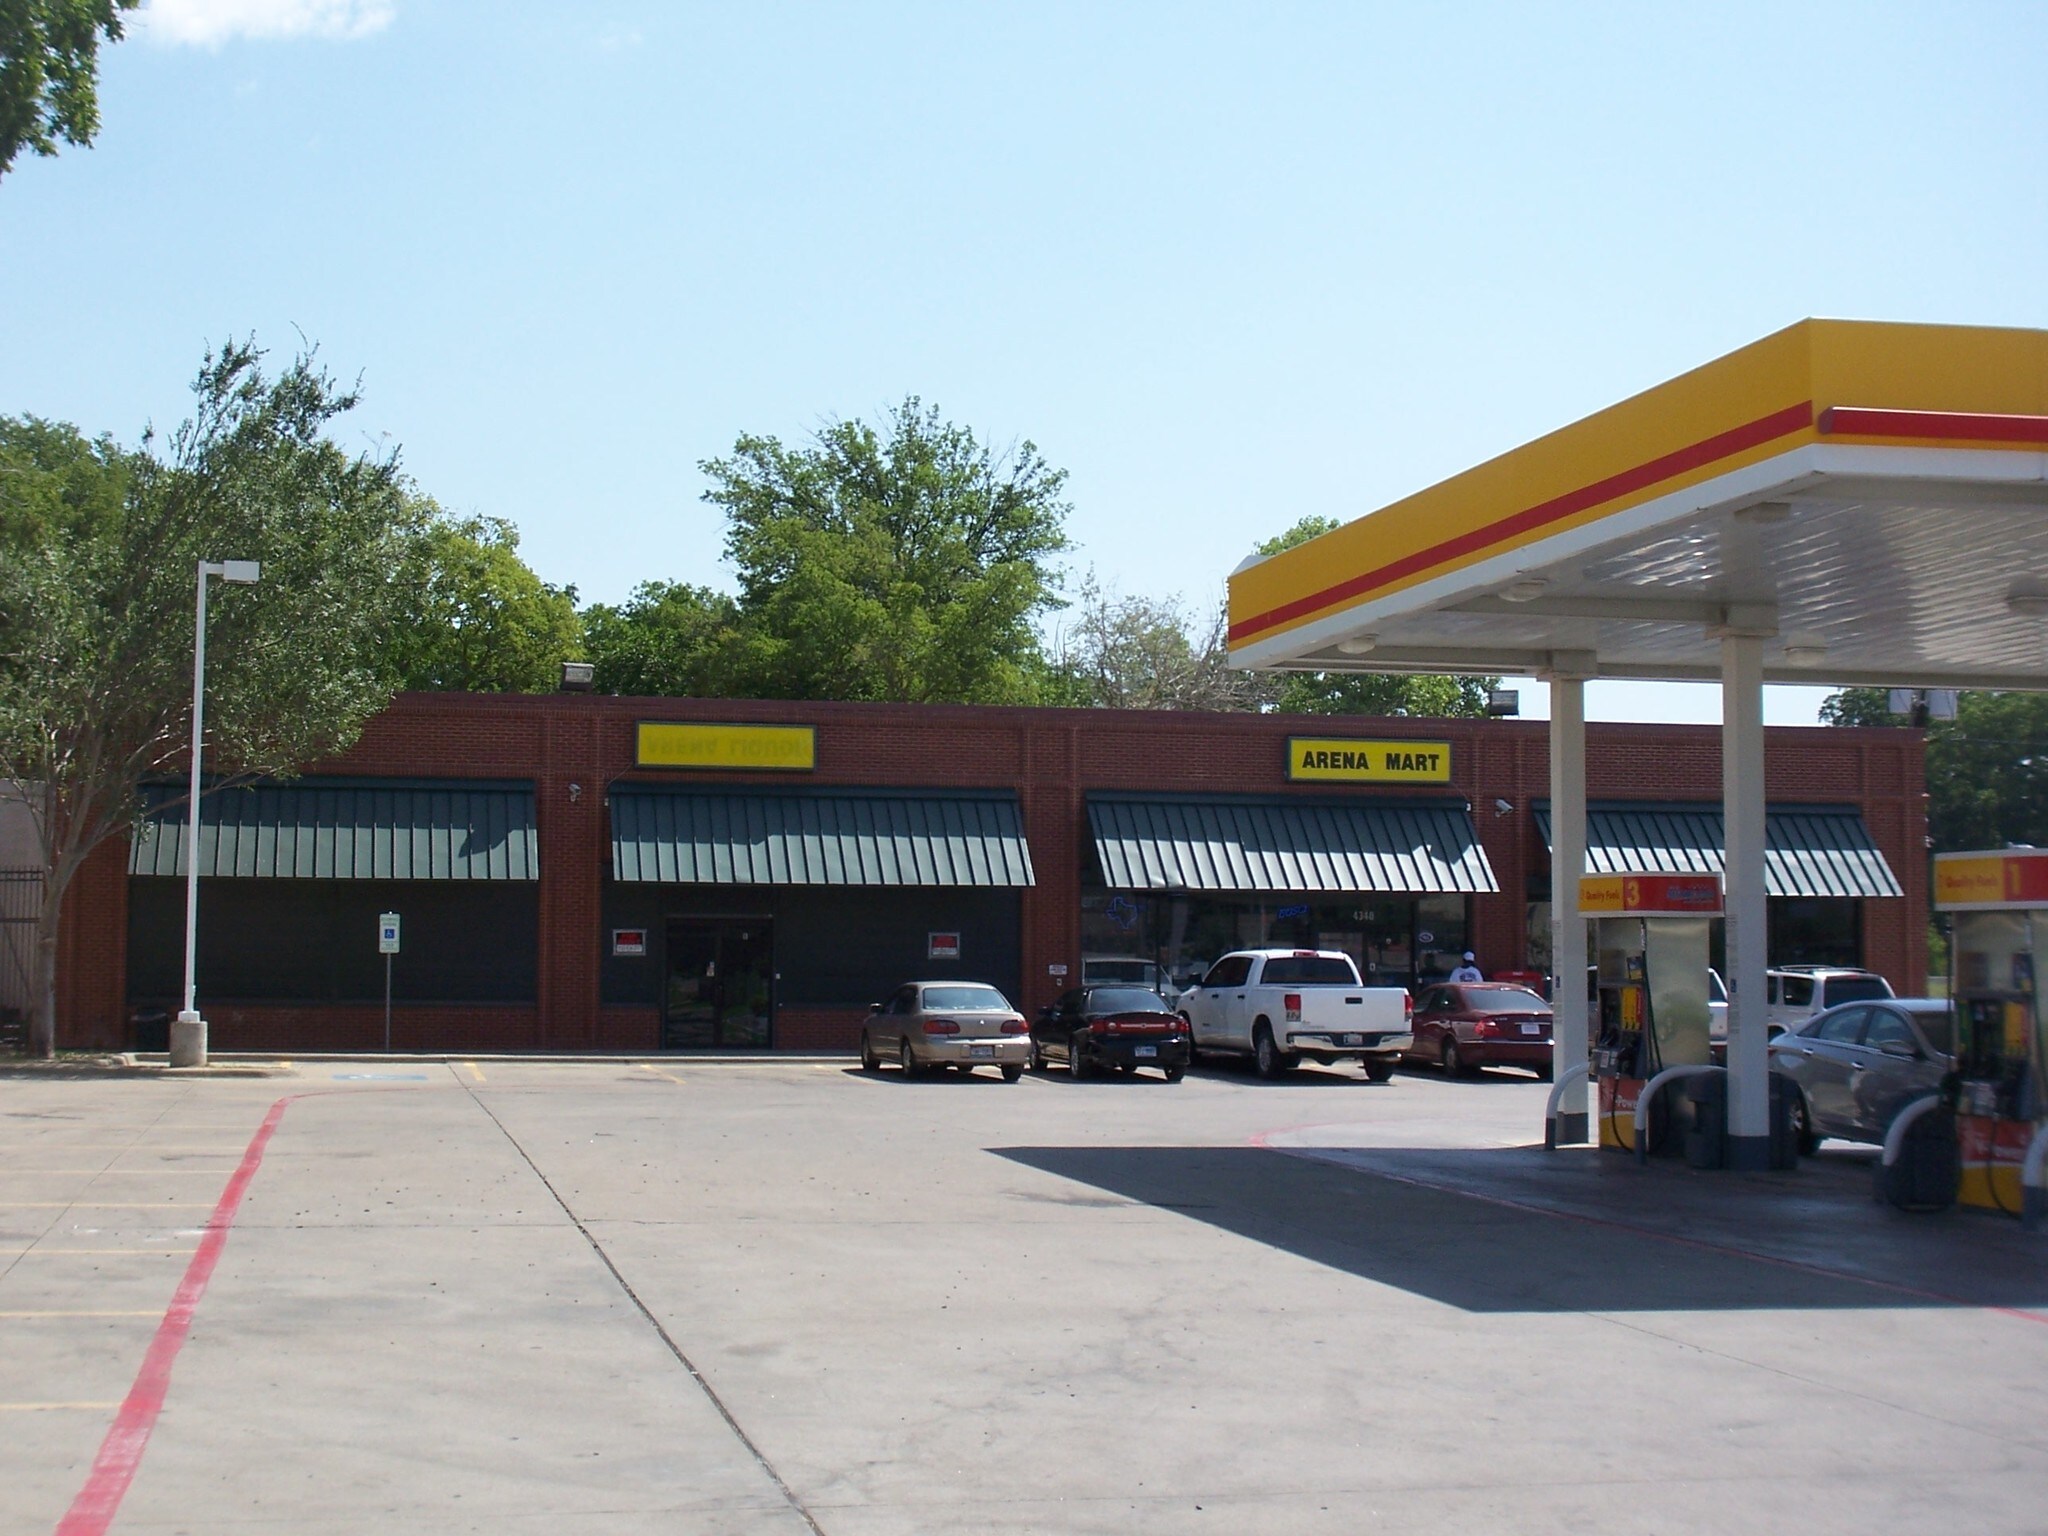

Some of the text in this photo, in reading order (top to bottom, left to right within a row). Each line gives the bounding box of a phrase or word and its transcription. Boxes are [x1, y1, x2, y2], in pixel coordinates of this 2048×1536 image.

[1302, 751, 1440, 773] ARENA MART
[2008, 863, 2021, 895] 1
[1627, 880, 1640, 906] 3
